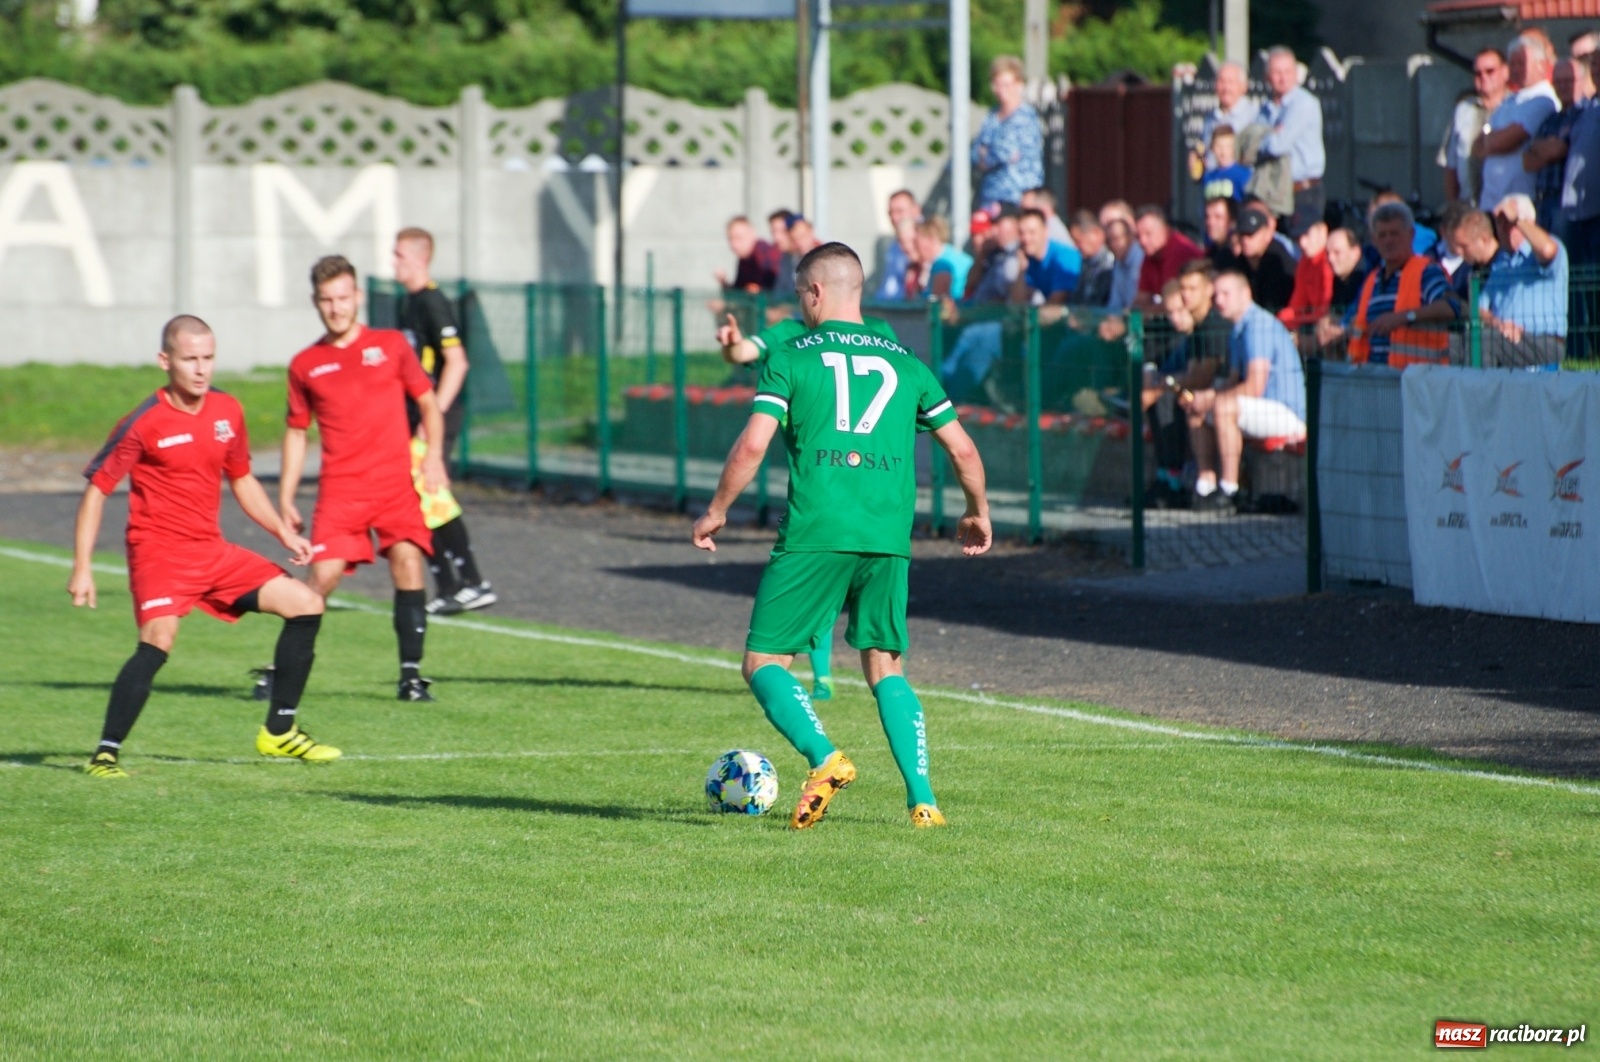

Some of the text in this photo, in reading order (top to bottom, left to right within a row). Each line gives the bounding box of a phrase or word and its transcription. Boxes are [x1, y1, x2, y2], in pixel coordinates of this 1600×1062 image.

[796, 333, 824, 350] LKS
[820, 351, 899, 434] 17
[912, 711, 928, 776] TWORKOW
